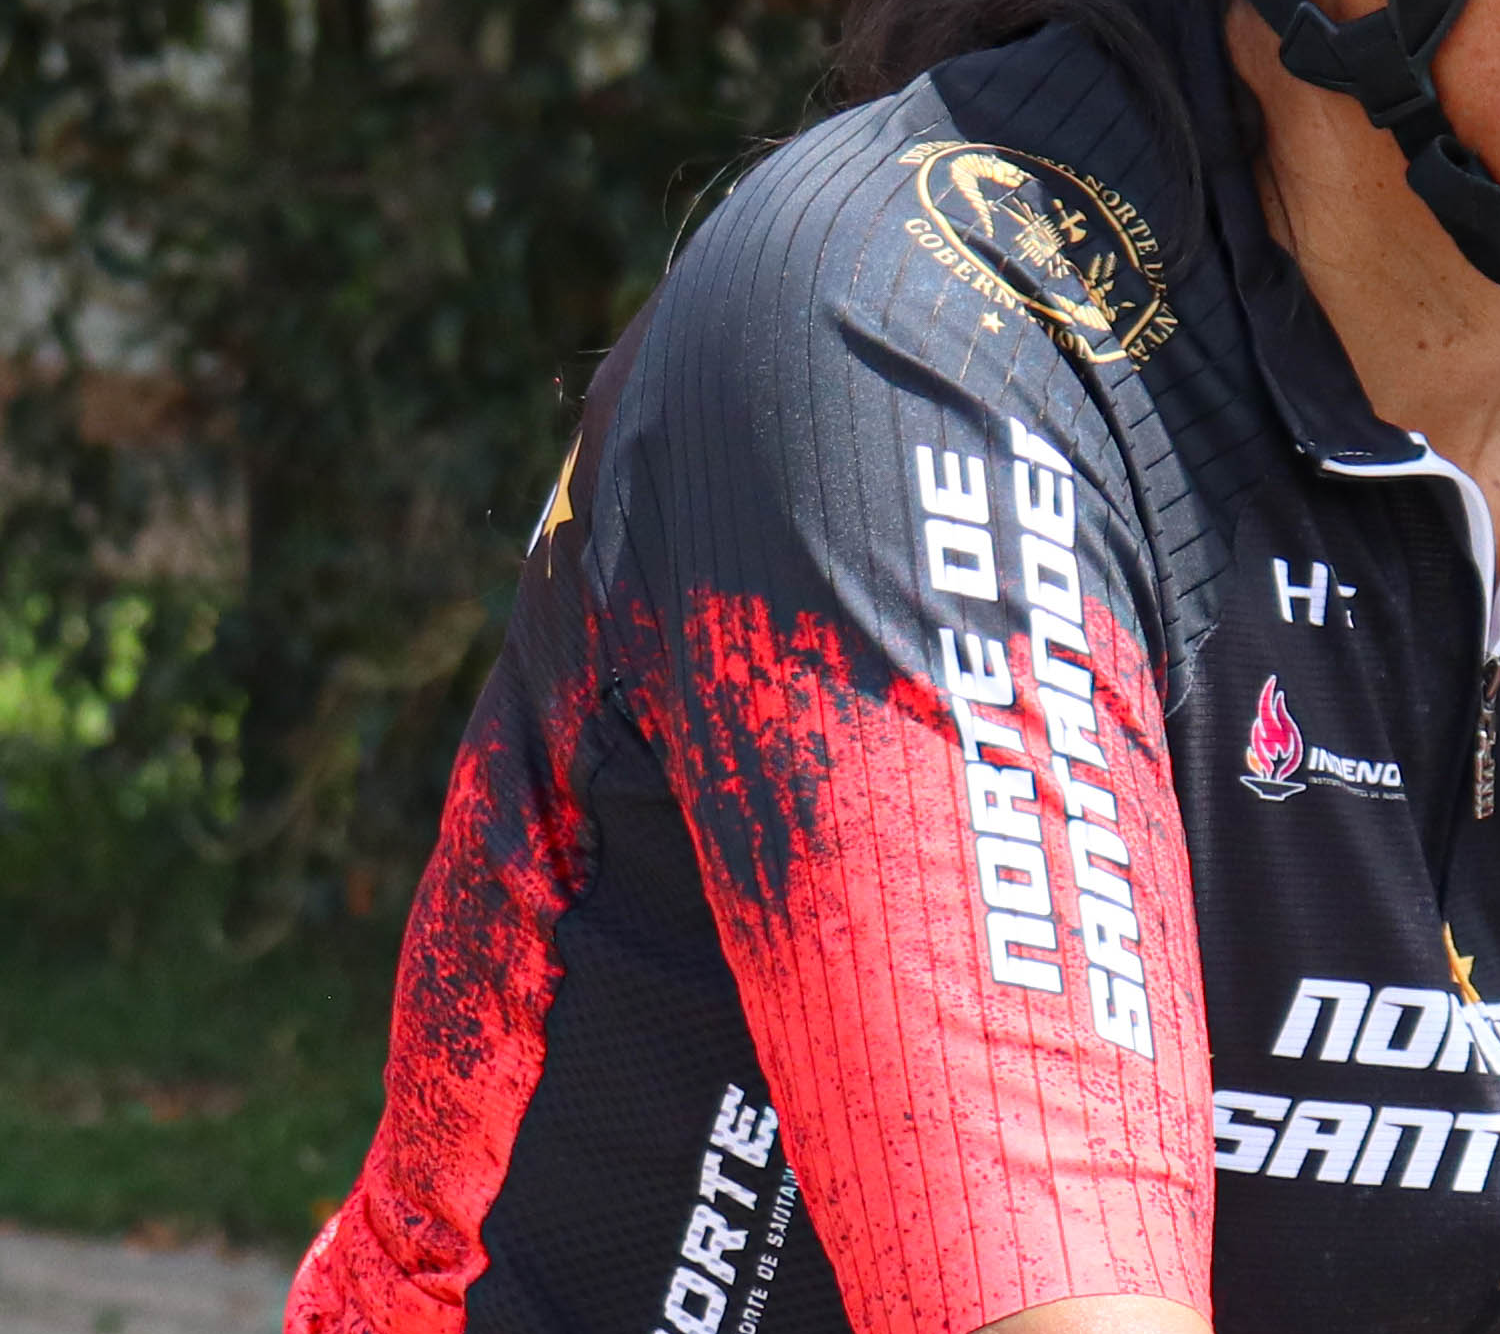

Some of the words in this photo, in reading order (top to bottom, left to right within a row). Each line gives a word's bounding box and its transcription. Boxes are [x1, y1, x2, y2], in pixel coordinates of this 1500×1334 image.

[1085, 174, 1159, 258] NORTE
[916, 443, 999, 604] DE
[938, 626, 1065, 995] NORTE
[757, 1253, 780, 1284] DE
